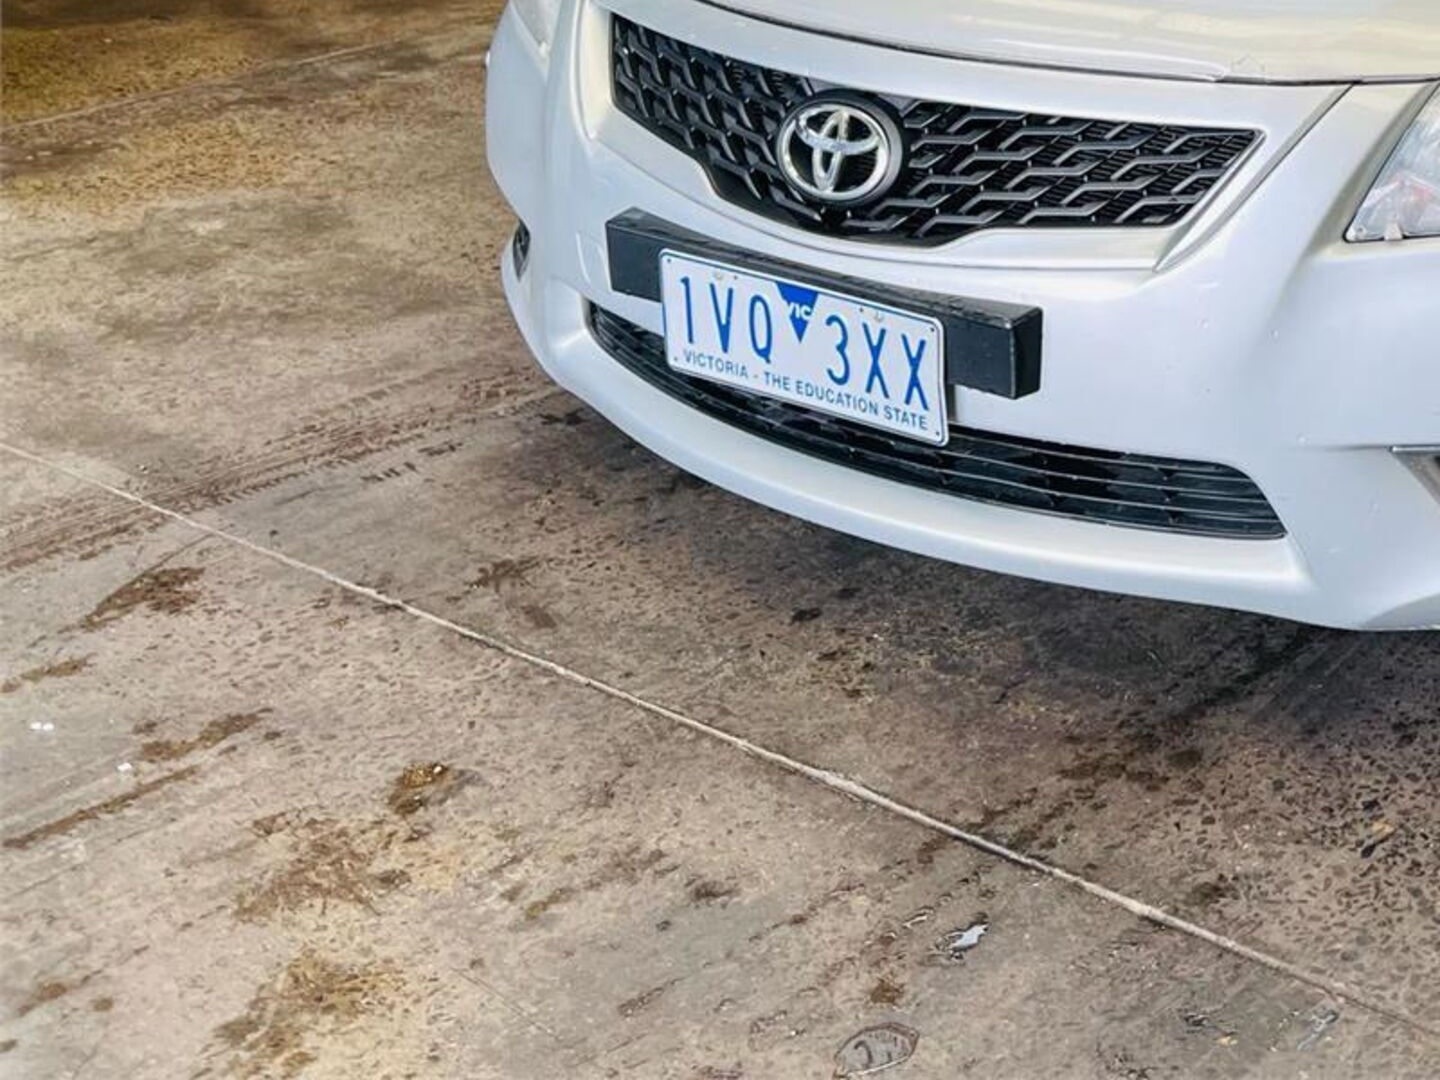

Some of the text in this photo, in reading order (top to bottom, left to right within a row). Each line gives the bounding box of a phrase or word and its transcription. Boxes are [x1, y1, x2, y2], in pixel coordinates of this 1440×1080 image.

[680, 276, 930, 411] 1VQ 3XX
[787, 302, 814, 321] VIC
[683, 349, 749, 380] VICTORIA
[764, 371, 792, 391] THE
[795, 380, 879, 417] EDUCATION
[883, 405, 929, 431] STATE
